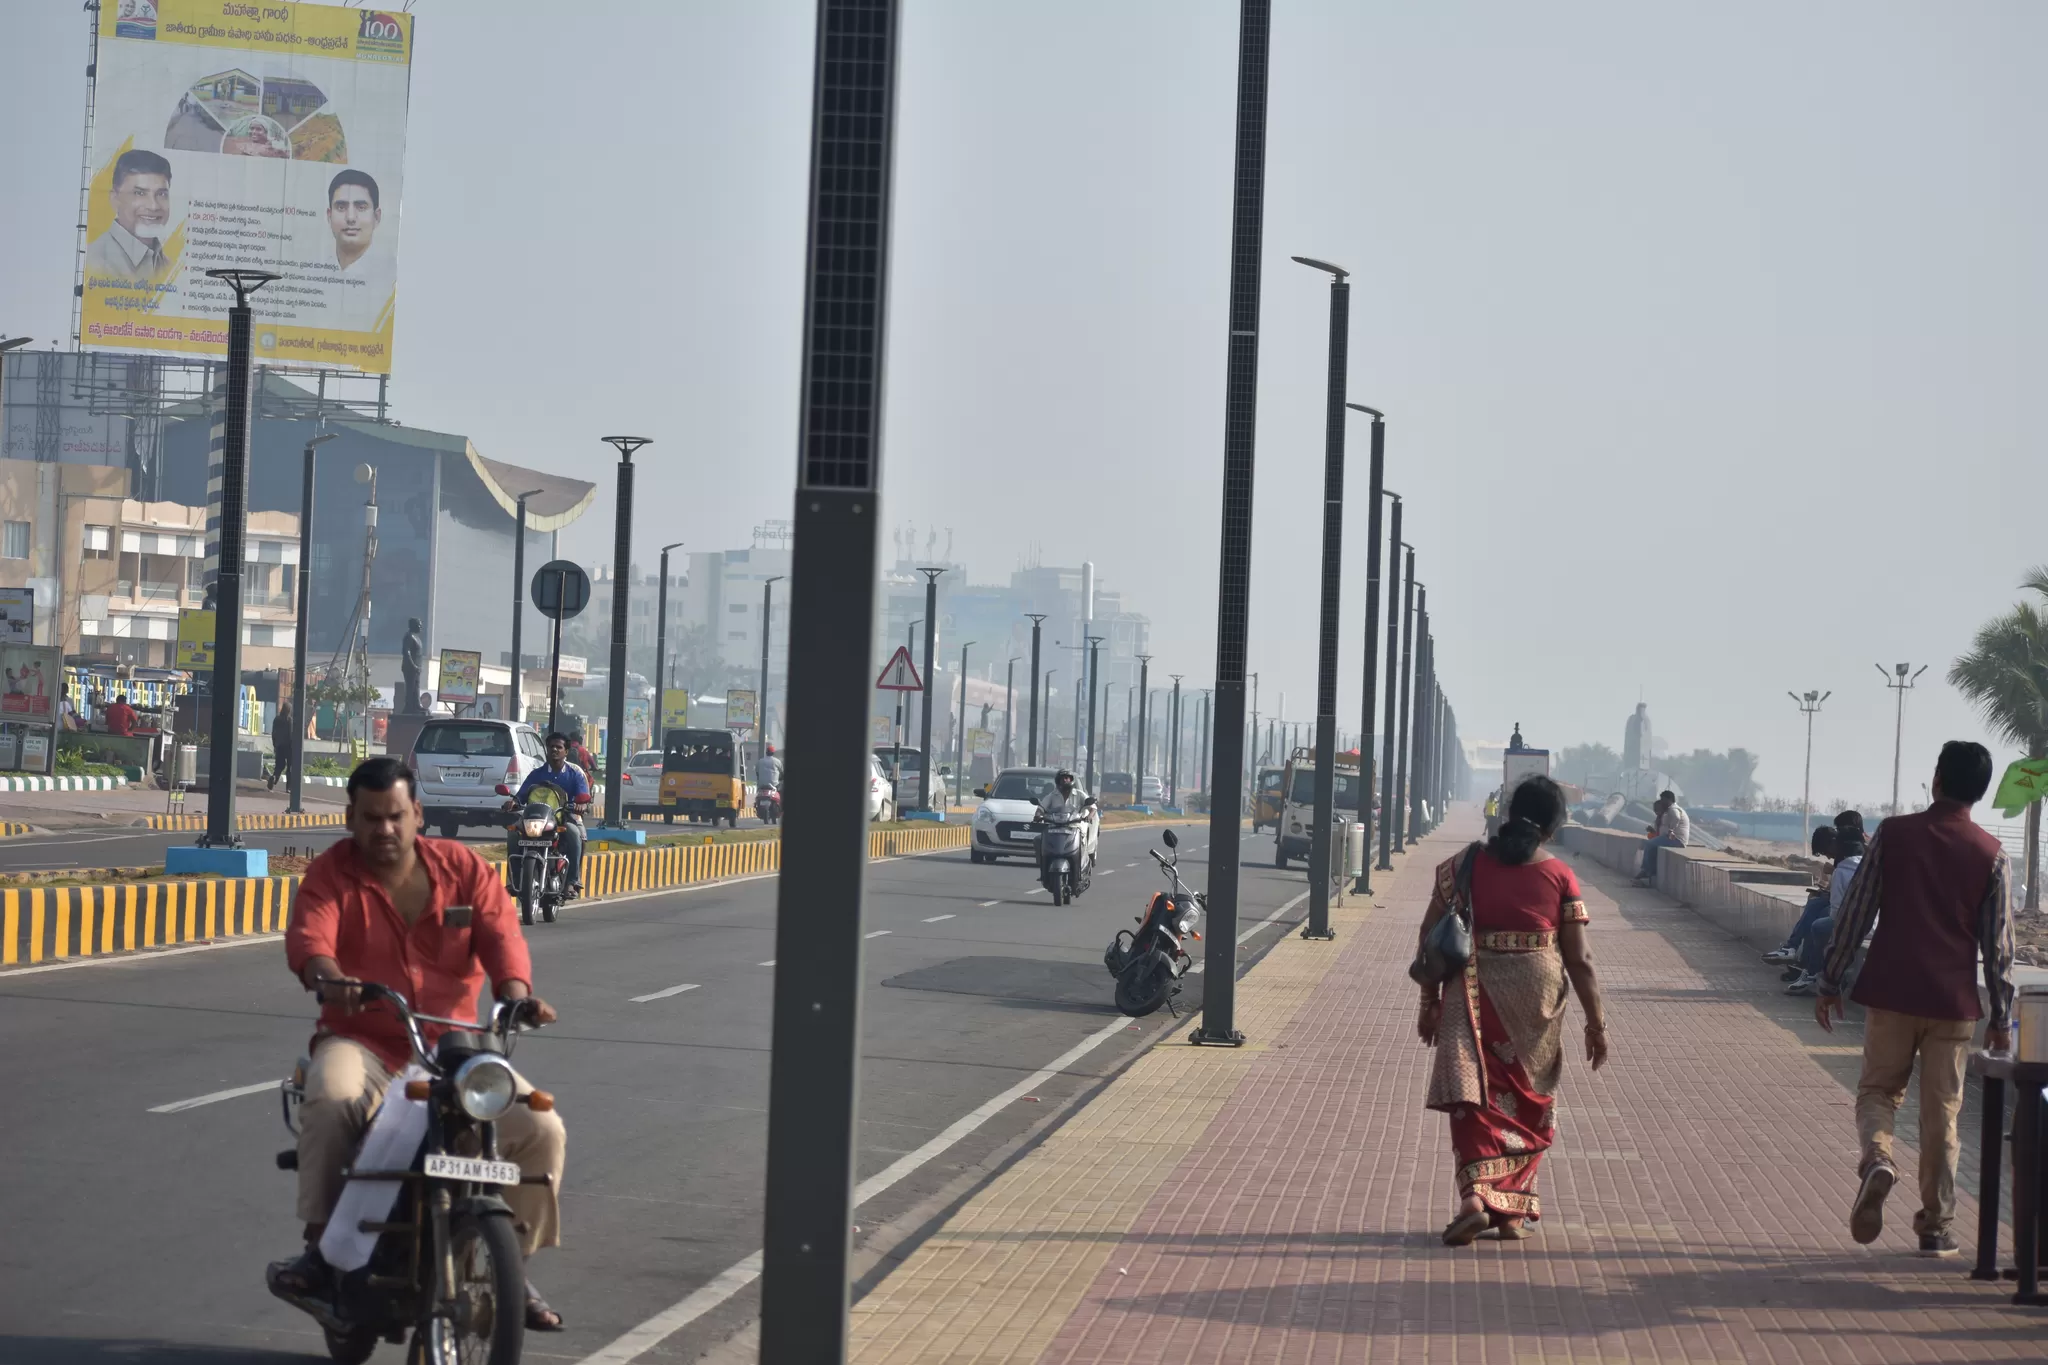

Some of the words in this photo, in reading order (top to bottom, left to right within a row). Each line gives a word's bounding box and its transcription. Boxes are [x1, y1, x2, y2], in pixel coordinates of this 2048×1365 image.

[222, 2, 260, 23] మహాత్మా
[262, 6, 289, 22] గాంధీ
[365, 21, 398, 40] 100
